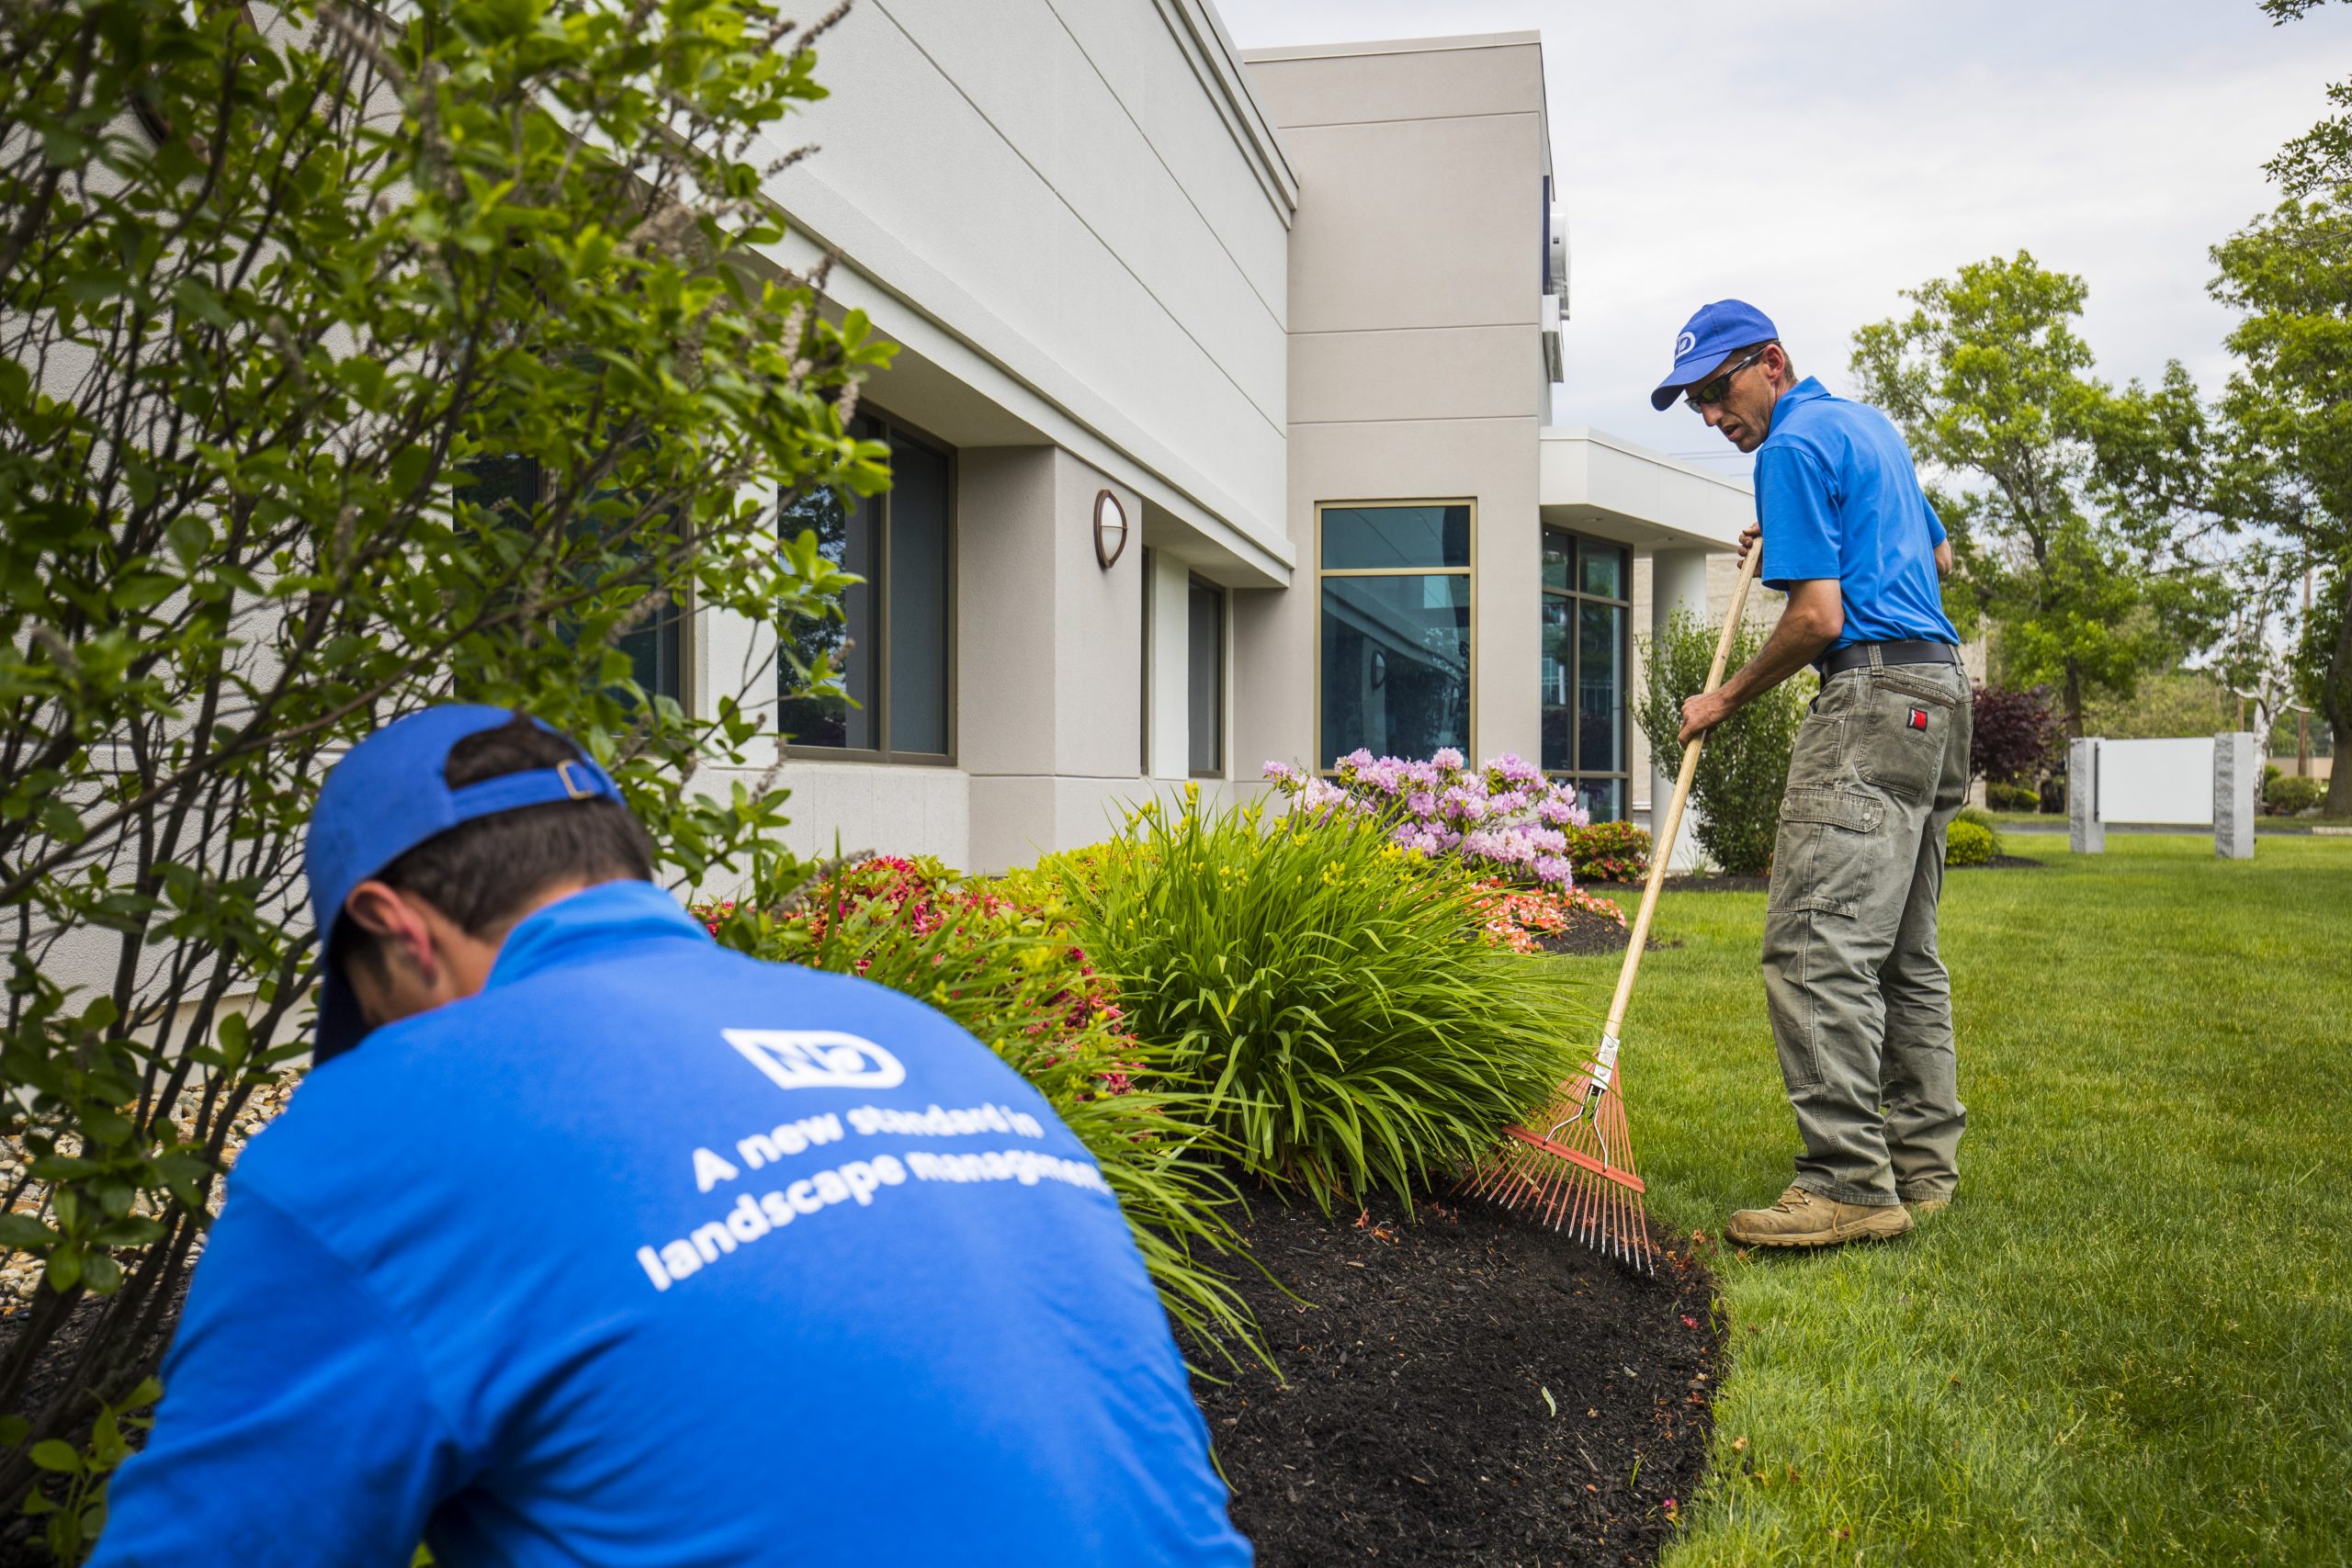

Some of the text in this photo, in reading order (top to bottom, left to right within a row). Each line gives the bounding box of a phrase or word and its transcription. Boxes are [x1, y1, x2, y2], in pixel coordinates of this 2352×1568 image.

[693, 1102, 1045, 1193] A new standard in
[636, 1154, 908, 1292] landscape
